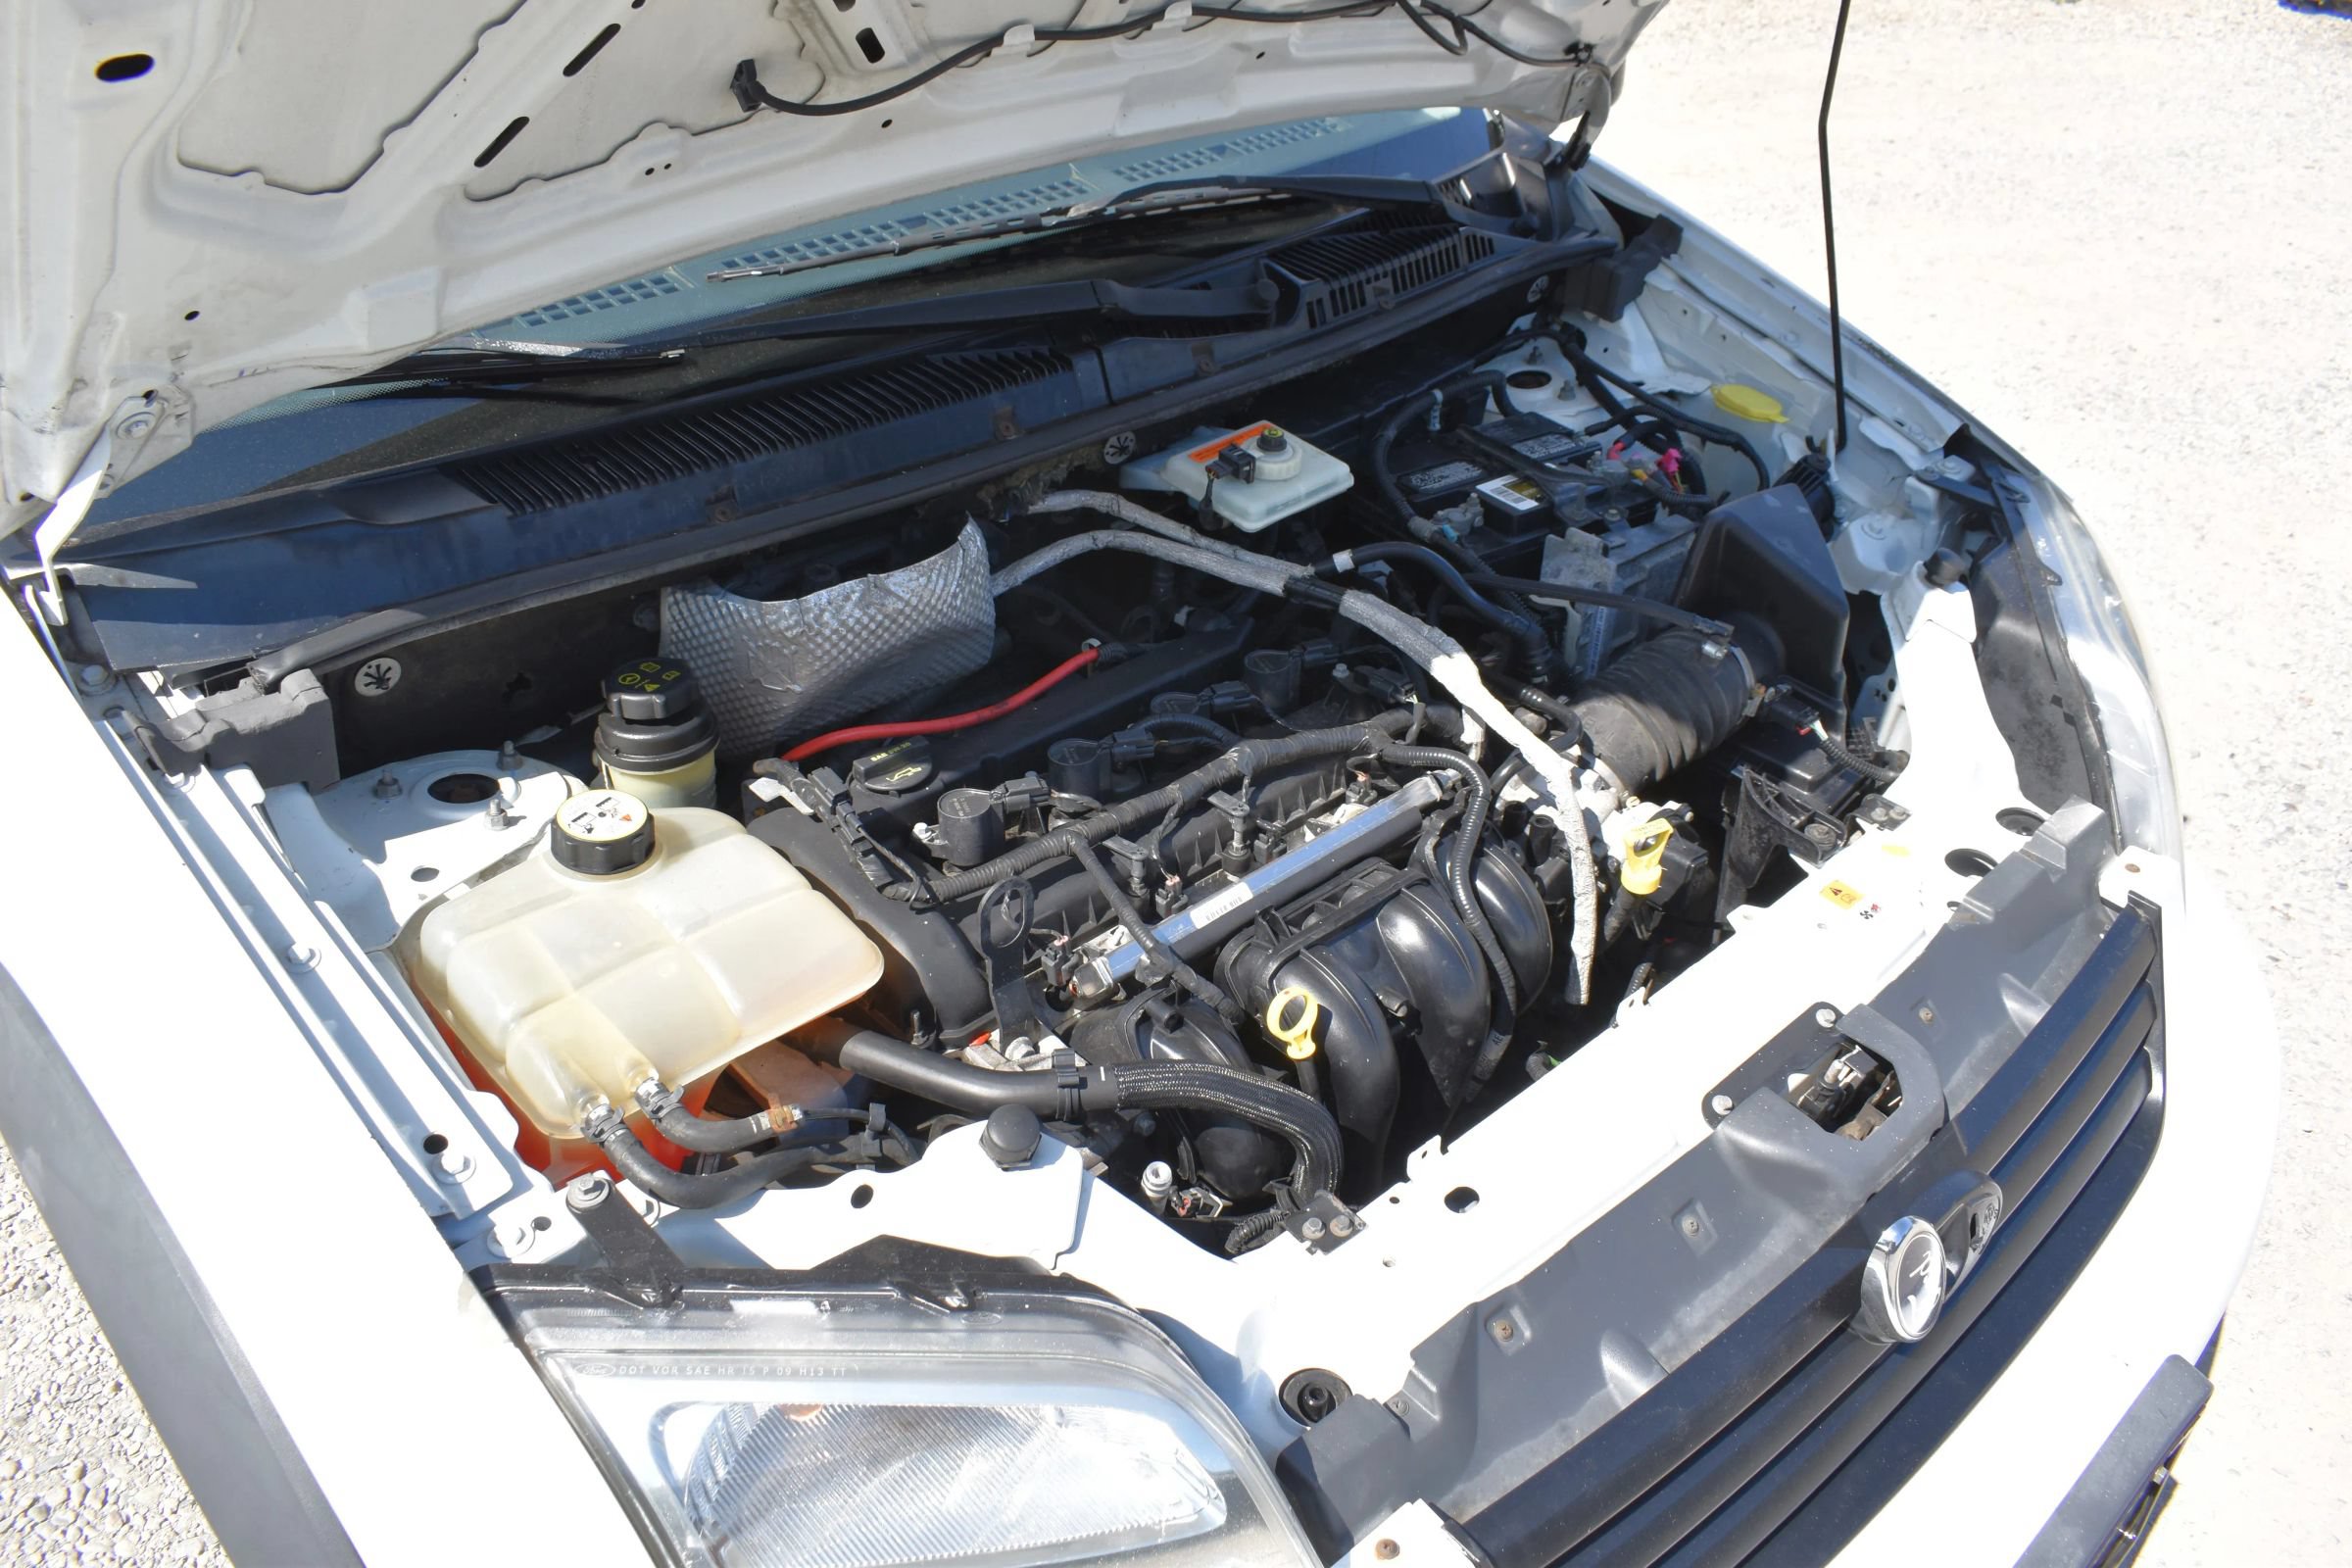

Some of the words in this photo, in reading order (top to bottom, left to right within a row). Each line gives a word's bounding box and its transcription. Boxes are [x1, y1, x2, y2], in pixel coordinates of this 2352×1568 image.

[618, 1365, 646, 1376] DOT
[652, 1365, 679, 1376] VOR
[686, 1365, 710, 1376] SAE
[717, 1364, 735, 1376] HR
[762, 1365, 769, 1376] P
[776, 1366, 792, 1377] 09
[799, 1365, 824, 1377] H13
